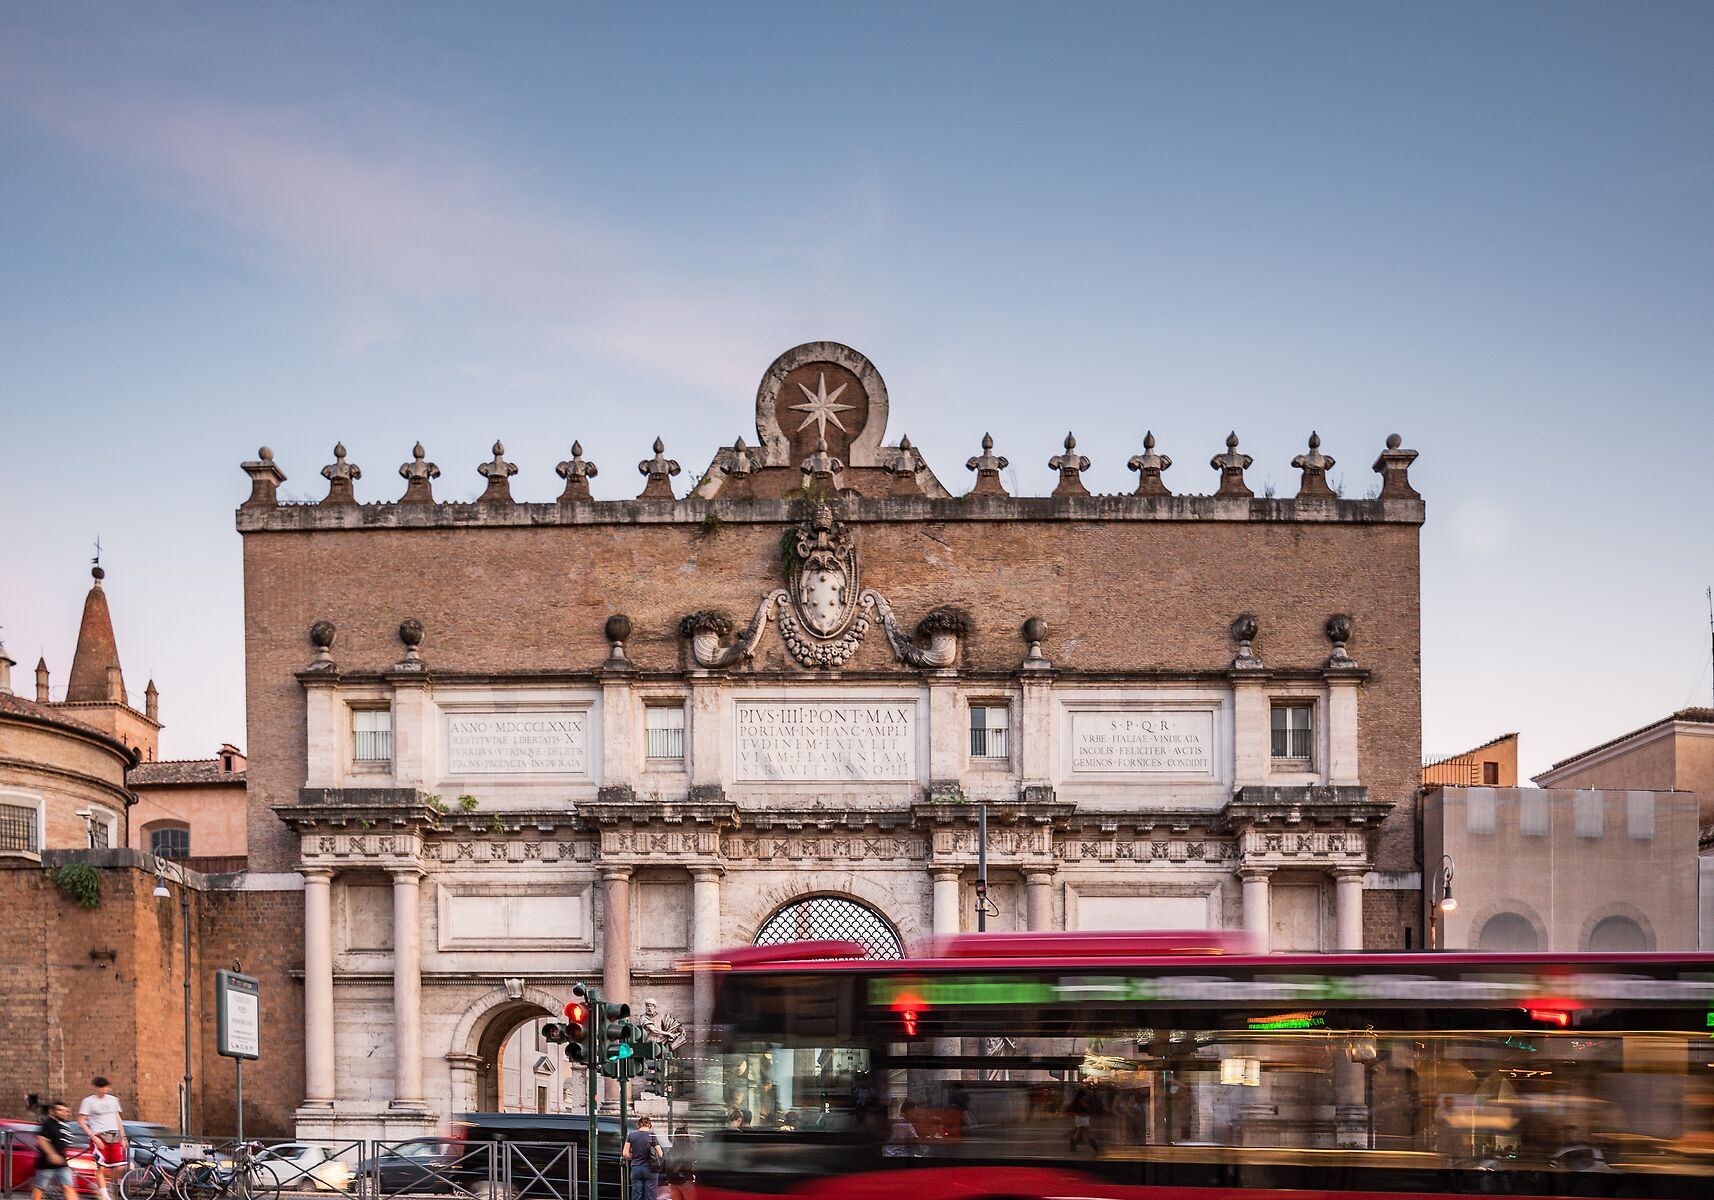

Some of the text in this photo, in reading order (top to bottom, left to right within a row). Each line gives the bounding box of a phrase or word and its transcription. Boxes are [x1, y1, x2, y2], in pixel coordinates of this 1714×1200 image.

[740, 710, 774, 723] PIVS
[809, 709, 861, 723] PONT
[866, 710, 908, 723] MAX
[451, 721, 487, 733] ANNO
[740, 726, 908, 736] PORTAM IN HANC AMPLI
[1119, 747, 1166, 755] FELICITER
[741, 753, 787, 762] VIAM
[452, 760, 480, 768] FRONS
[1074, 759, 1208, 767] GEMINOS FORNICES CONDIDIT
[743, 765, 820, 775] STRAVIT
[833, 765, 883, 775] ANNO
